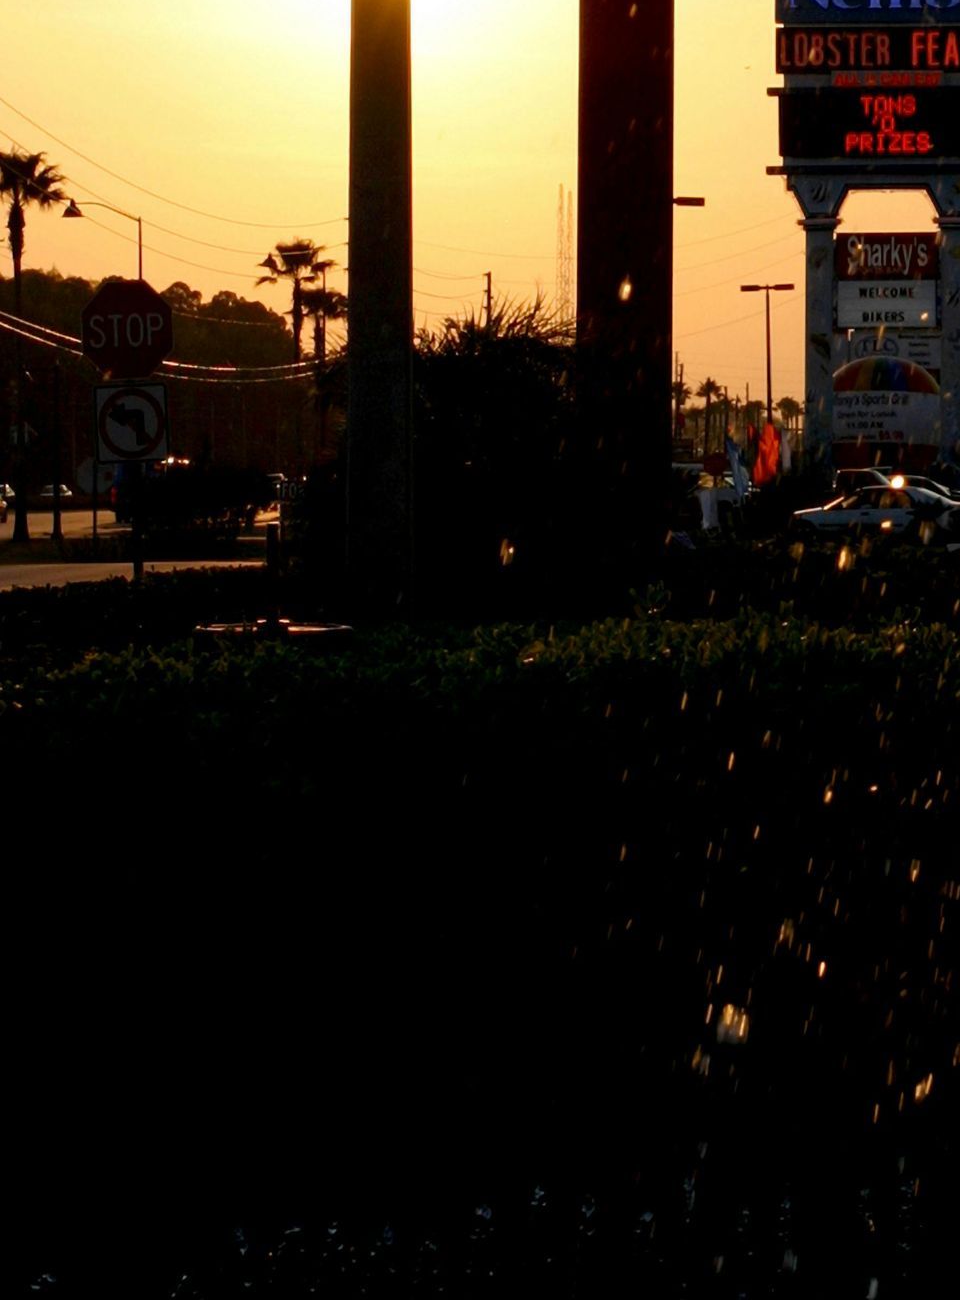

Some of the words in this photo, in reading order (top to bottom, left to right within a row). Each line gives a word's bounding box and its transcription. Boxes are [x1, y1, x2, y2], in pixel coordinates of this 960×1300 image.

[780, 32, 891, 67] LOBSTER
[859, 94, 917, 118] TONS
[844, 131, 932, 156] PRIZES
[847, 235, 928, 276] Sharky's
[859, 287, 914, 298] WELCOME
[89, 312, 164, 349] STOP
